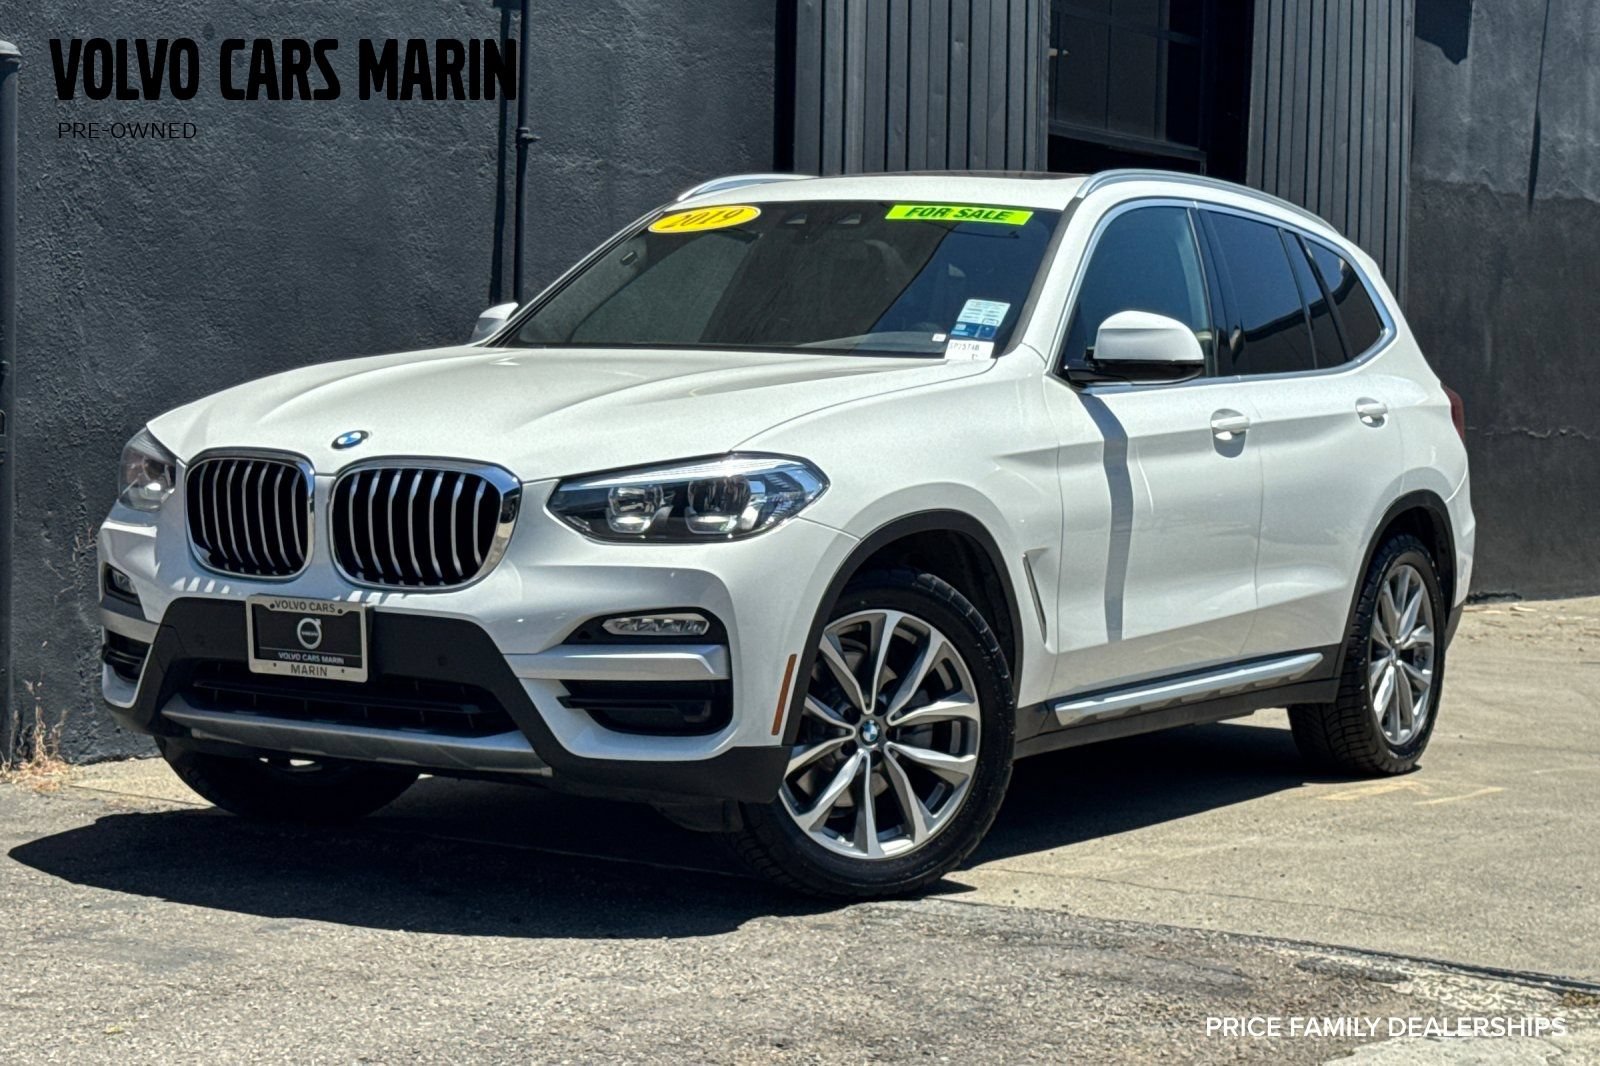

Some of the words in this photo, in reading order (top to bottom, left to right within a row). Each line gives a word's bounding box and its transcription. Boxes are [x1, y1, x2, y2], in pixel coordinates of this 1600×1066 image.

[660, 208, 745, 229] 2019
[904, 207, 953, 218] FOR
[954, 208, 1015, 220] SALE
[274, 600, 307, 611] VOLVO
[309, 602, 336, 613] CARS
[278, 652, 301, 661] VOLVO
[302, 654, 320, 663] CARS
[321, 656, 345, 665] MARIN
[290, 664, 328, 676] MARIN
